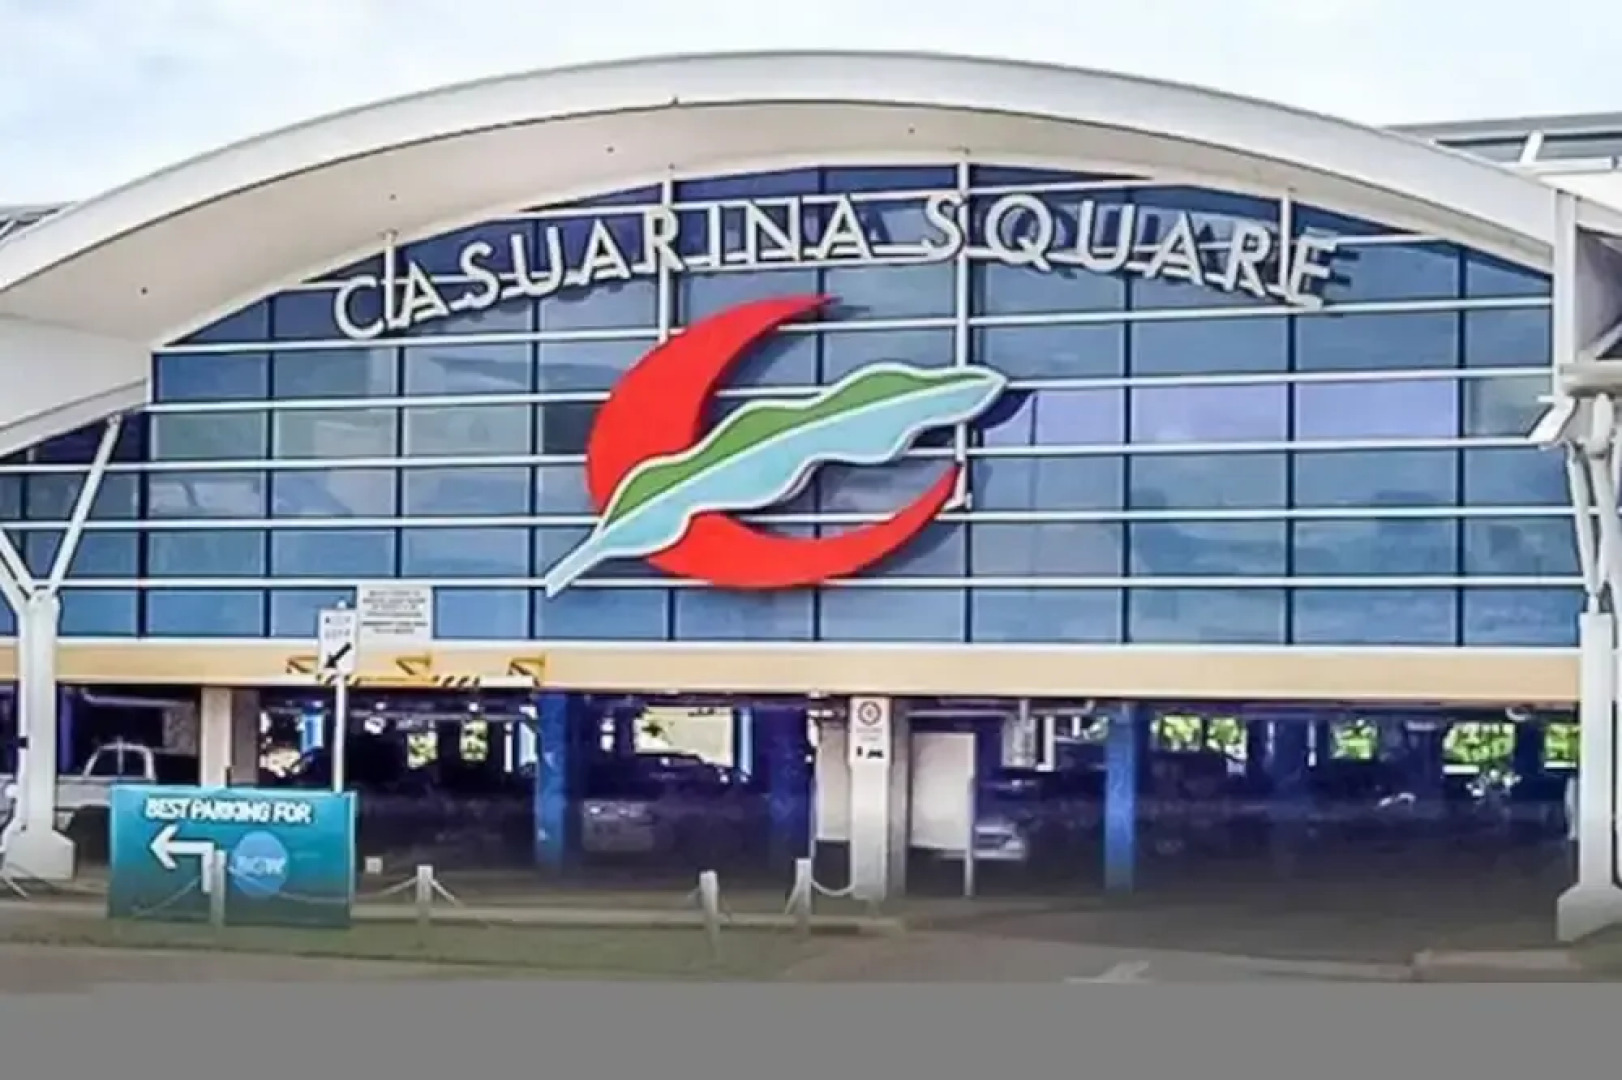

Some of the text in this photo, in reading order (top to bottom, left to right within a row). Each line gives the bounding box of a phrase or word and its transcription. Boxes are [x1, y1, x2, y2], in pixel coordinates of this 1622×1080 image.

[334, 192, 1340, 340] CASUARINA SQUARE
[146, 798, 190, 820] BEST
[273, 802, 311, 824] FOR
